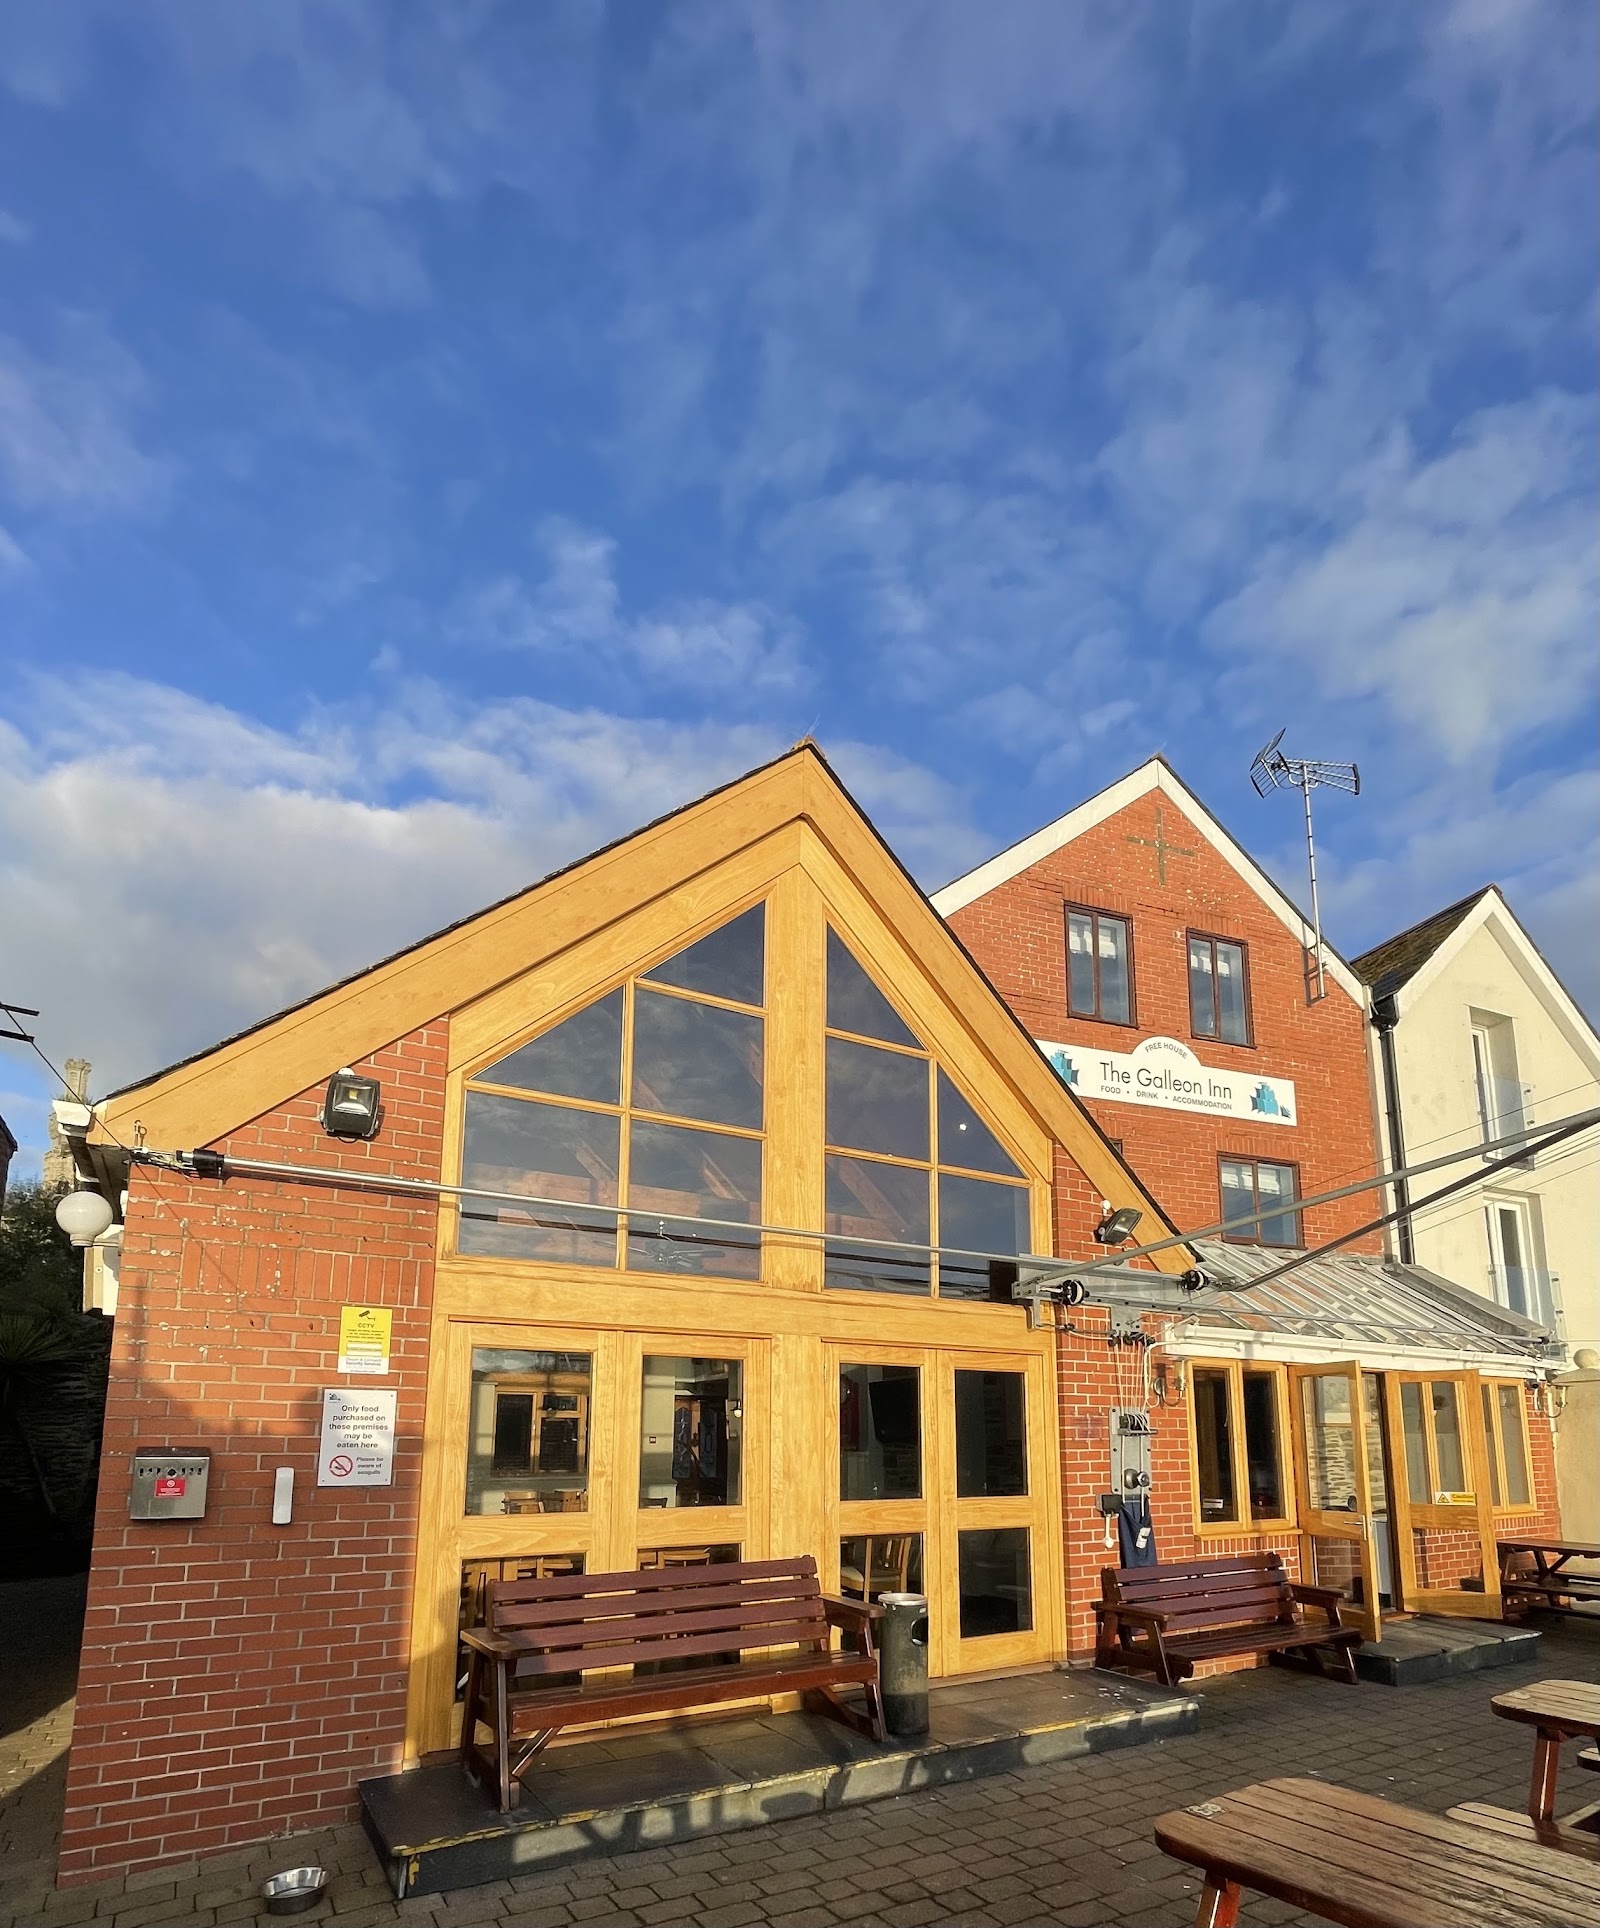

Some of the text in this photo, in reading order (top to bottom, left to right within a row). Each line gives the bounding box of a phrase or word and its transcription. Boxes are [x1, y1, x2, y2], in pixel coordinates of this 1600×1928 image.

[1144, 1042, 1188, 1059] FREE HOUSE
[1099, 1060, 1232, 1099] The Galleon Inn
[1100, 1085, 1233, 1110] FOOD DRINK ACCOMMODATION
[341, 1405, 360, 1413] Only
